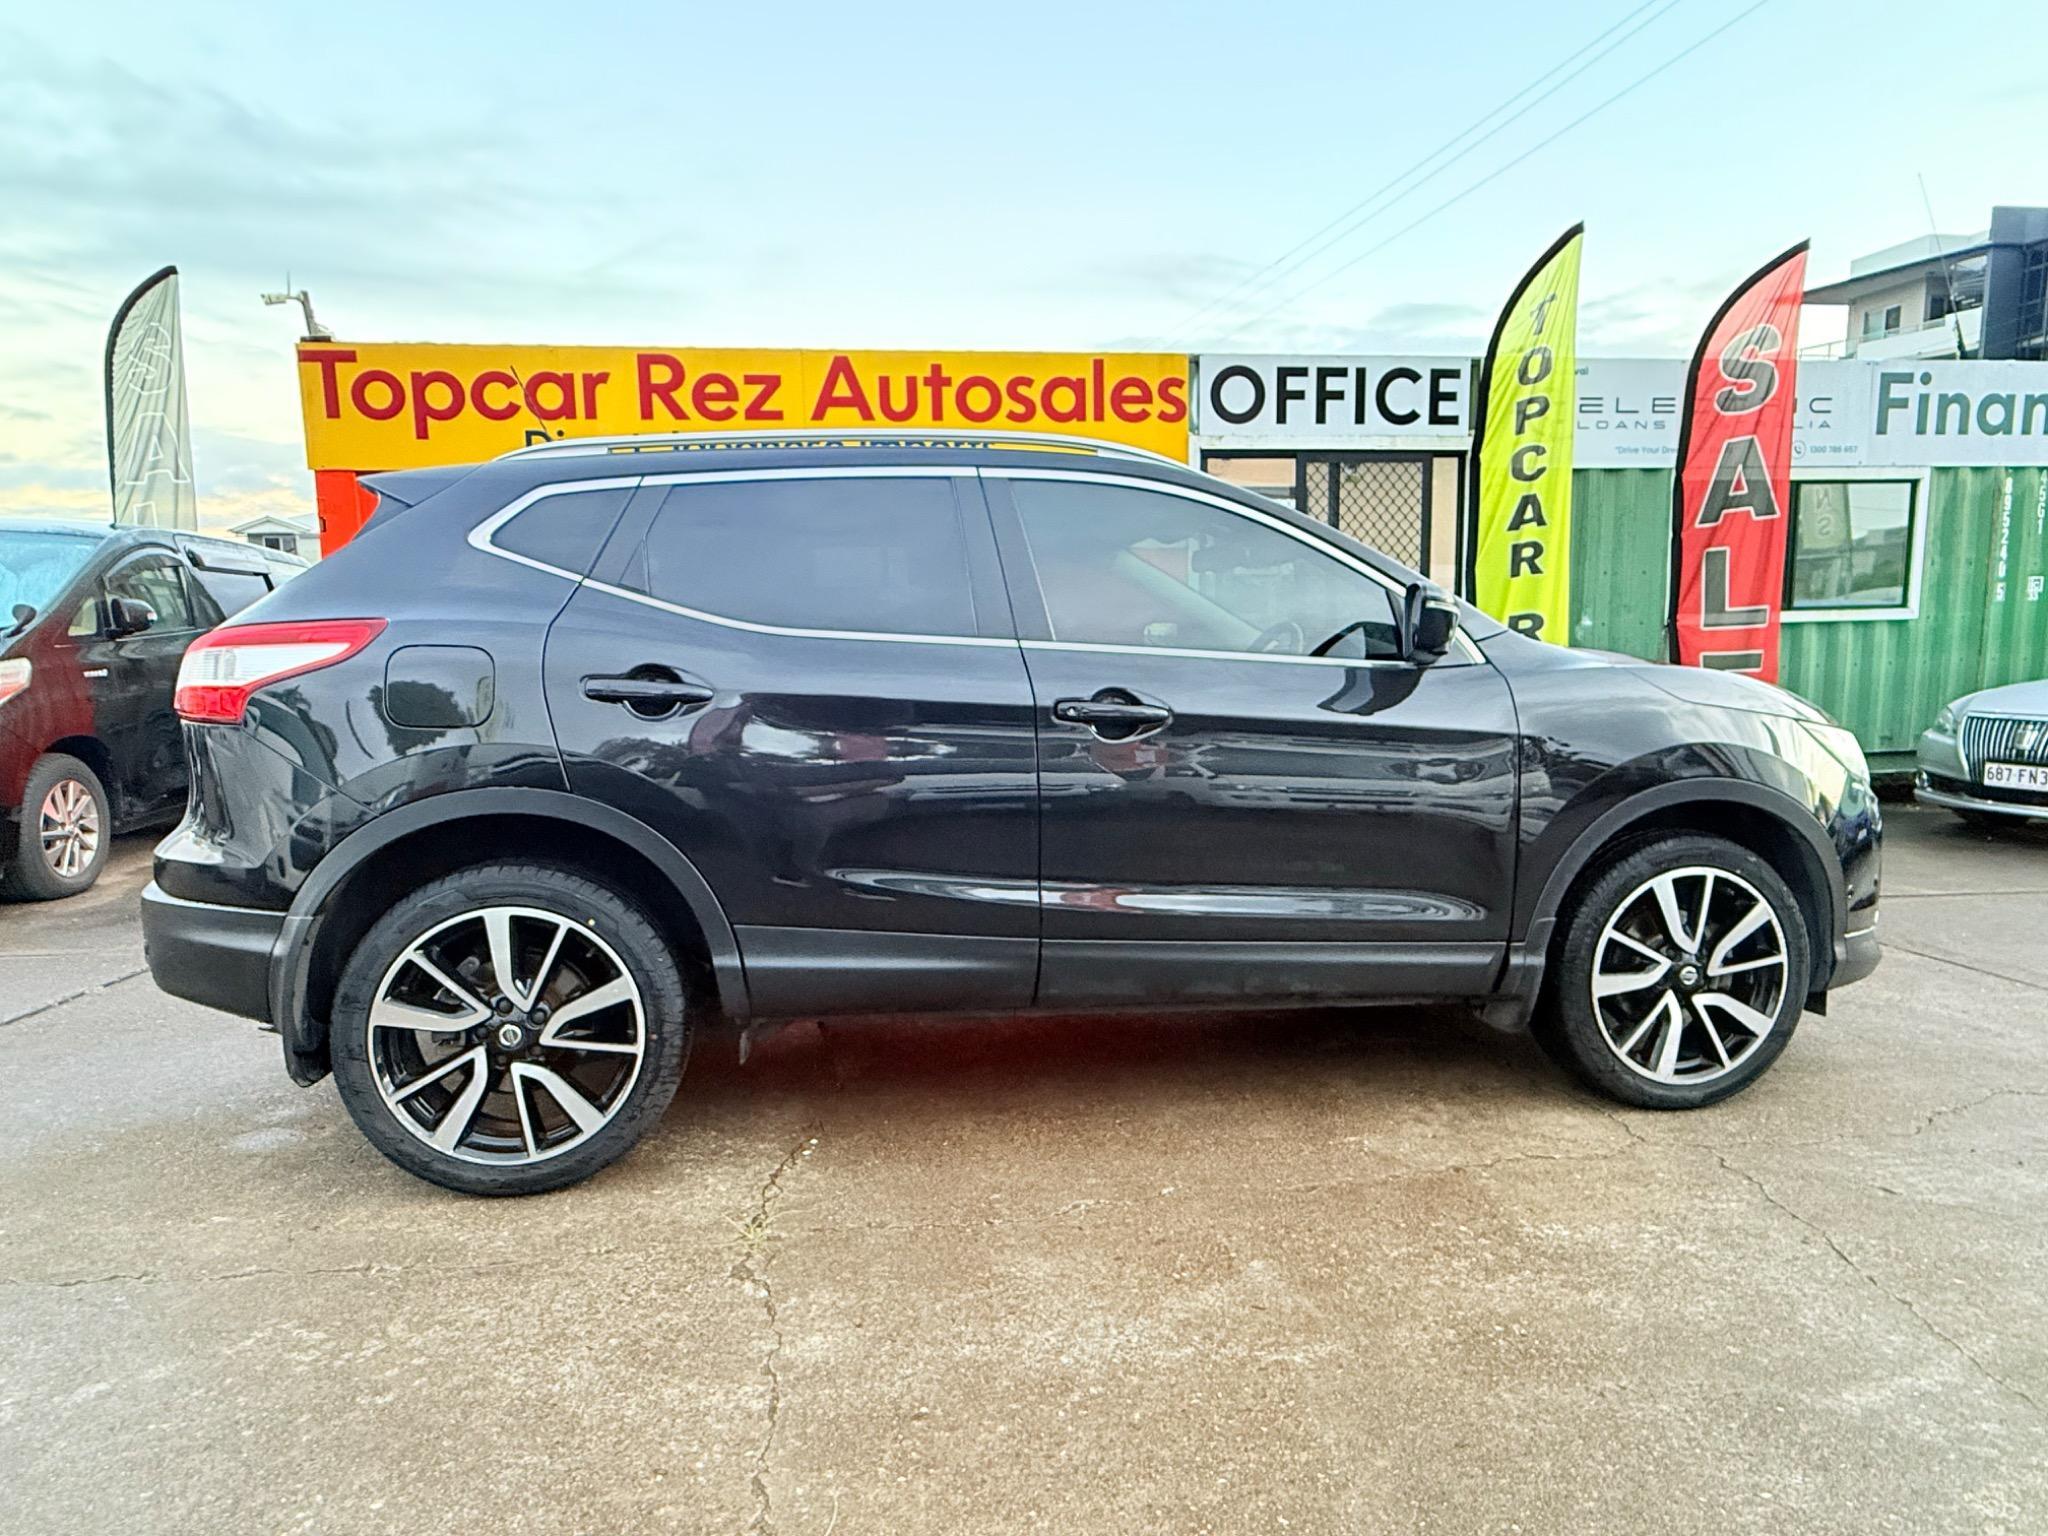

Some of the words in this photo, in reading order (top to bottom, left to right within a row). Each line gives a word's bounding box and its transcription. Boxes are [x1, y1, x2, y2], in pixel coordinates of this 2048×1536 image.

[125, 322, 191, 528] SA
[297, 350, 610, 440] Topcar
[637, 353, 783, 421] Rez
[810, 355, 1188, 423] Autosales
[1210, 365, 1461, 425] OFFICE
[1577, 420, 1666, 430] LOANS
[1507, 292, 1557, 578] TOPCAR
[1987, 766, 2012, 782] 687
